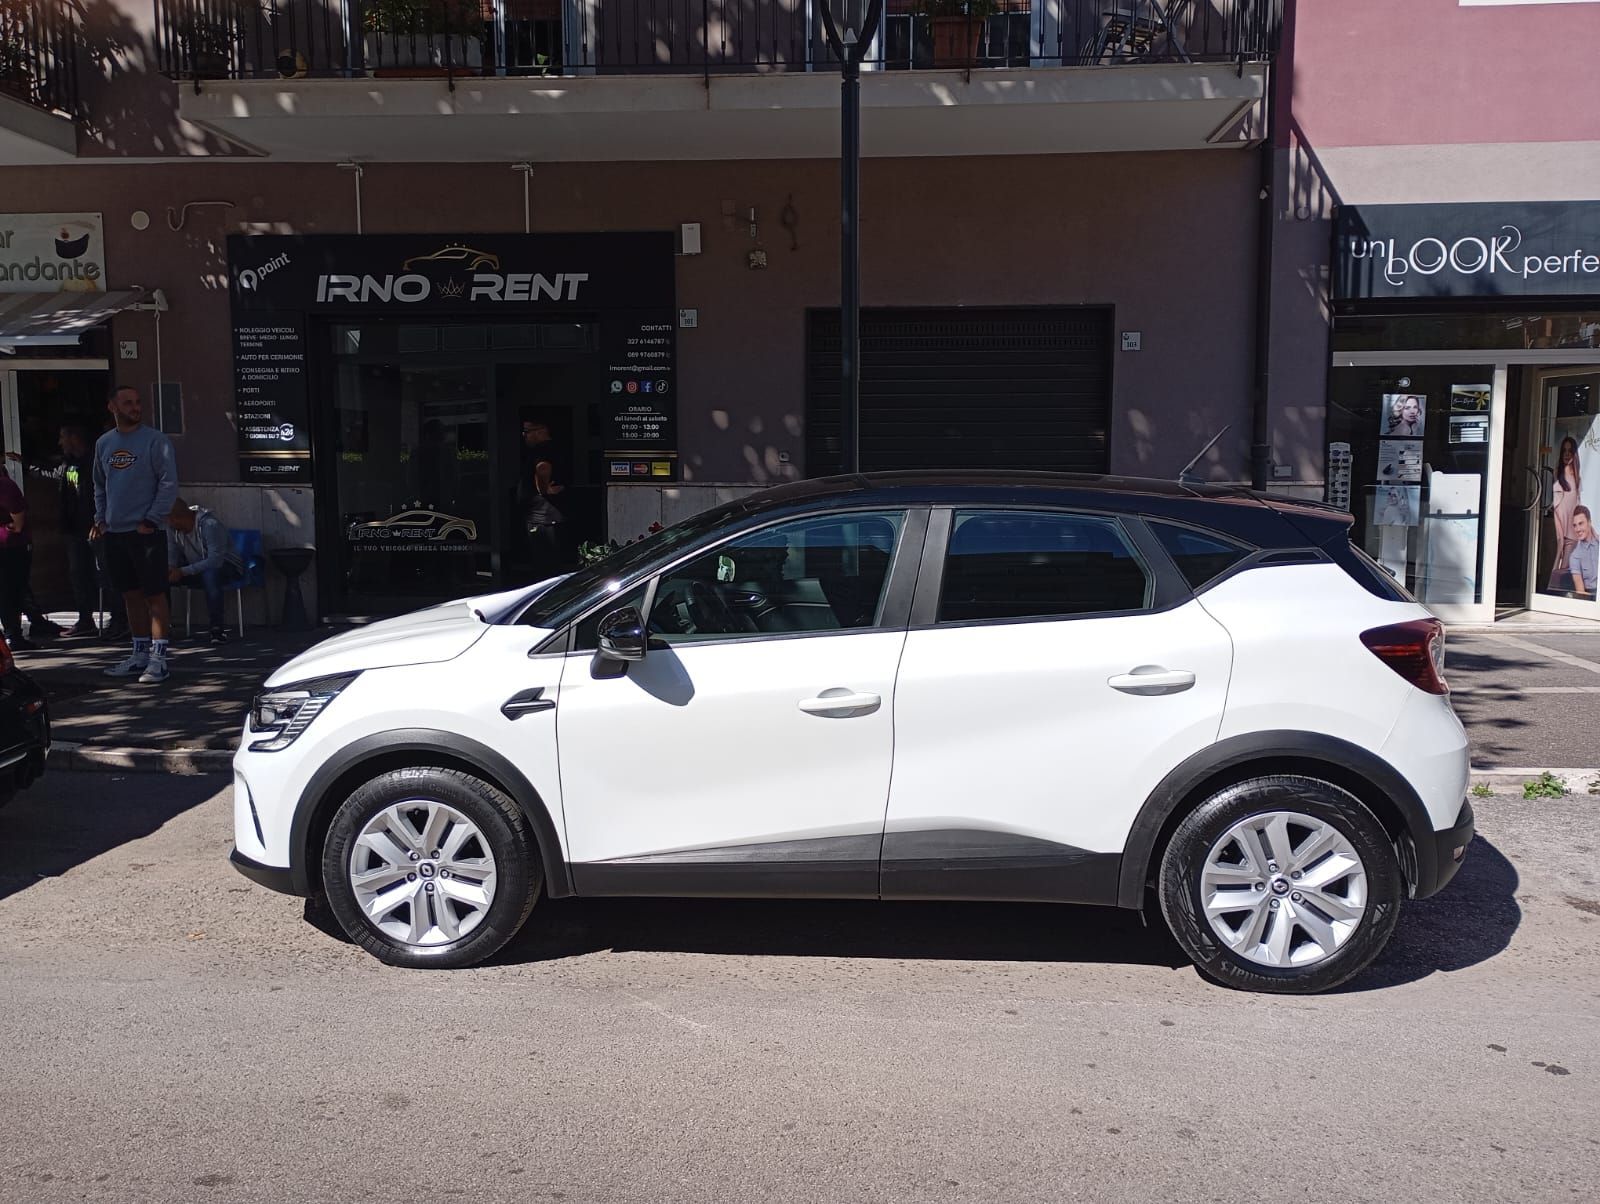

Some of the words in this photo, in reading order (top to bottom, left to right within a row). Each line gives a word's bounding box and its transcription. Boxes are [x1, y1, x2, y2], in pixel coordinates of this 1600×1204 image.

[1351, 240, 1385, 258] un
[317, 274, 431, 303] IRNO
[470, 273, 589, 302] RENT
[358, 528, 391, 538] IRNO
[401, 528, 436, 538] RENT
